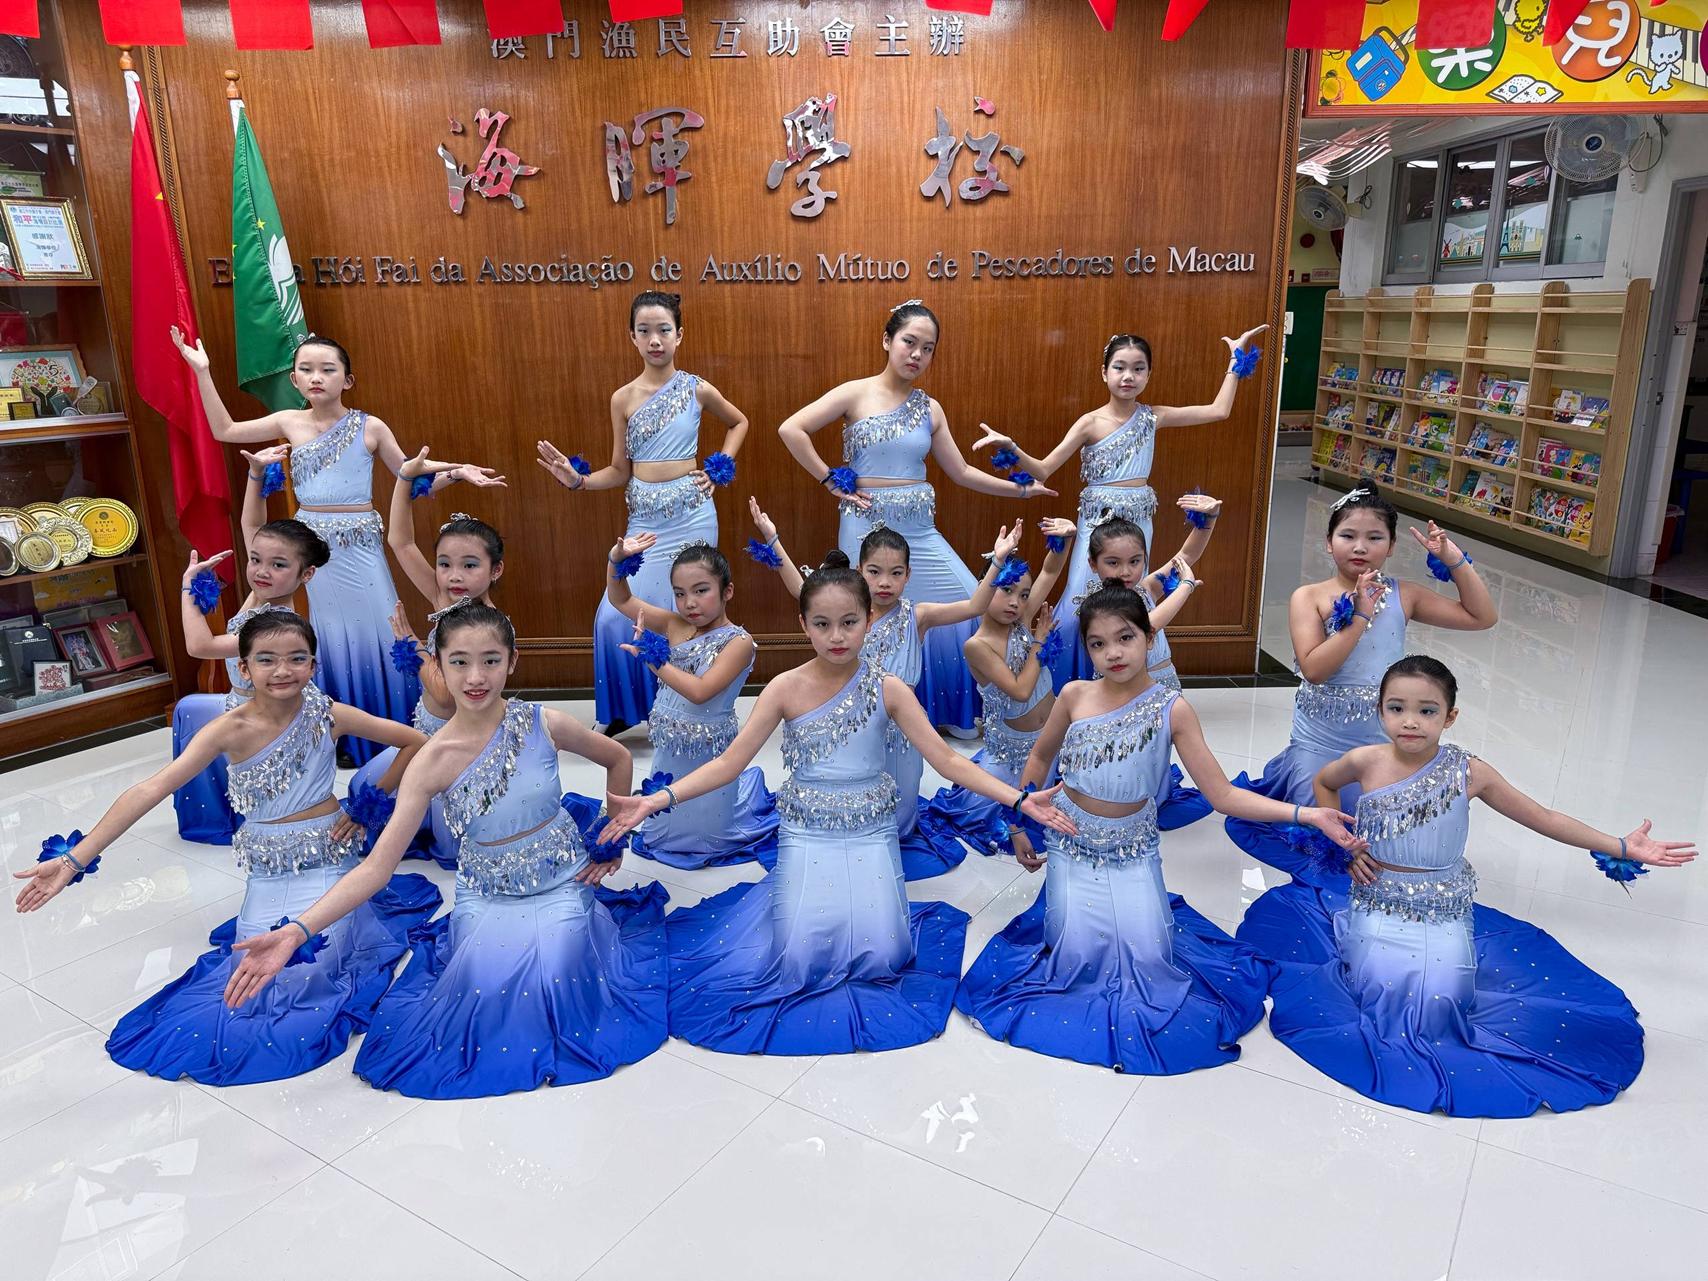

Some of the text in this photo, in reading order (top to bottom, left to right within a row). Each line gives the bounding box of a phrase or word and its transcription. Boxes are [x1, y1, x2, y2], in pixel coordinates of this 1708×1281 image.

[311, 256, 366, 284] Hói
[372, 256, 421, 284] Fai
[430, 256, 466, 283] da
[476, 253, 634, 289] Associação
[651, 256, 682, 282] de
[700, 254, 802, 282] Auxílio
[816, 252, 910, 280] Mútuo
[927, 252, 958, 279] de
[971, 249, 1114, 278] Pescadores
[1124, 248, 1156, 274] de
[1167, 246, 1256, 273] Macau
